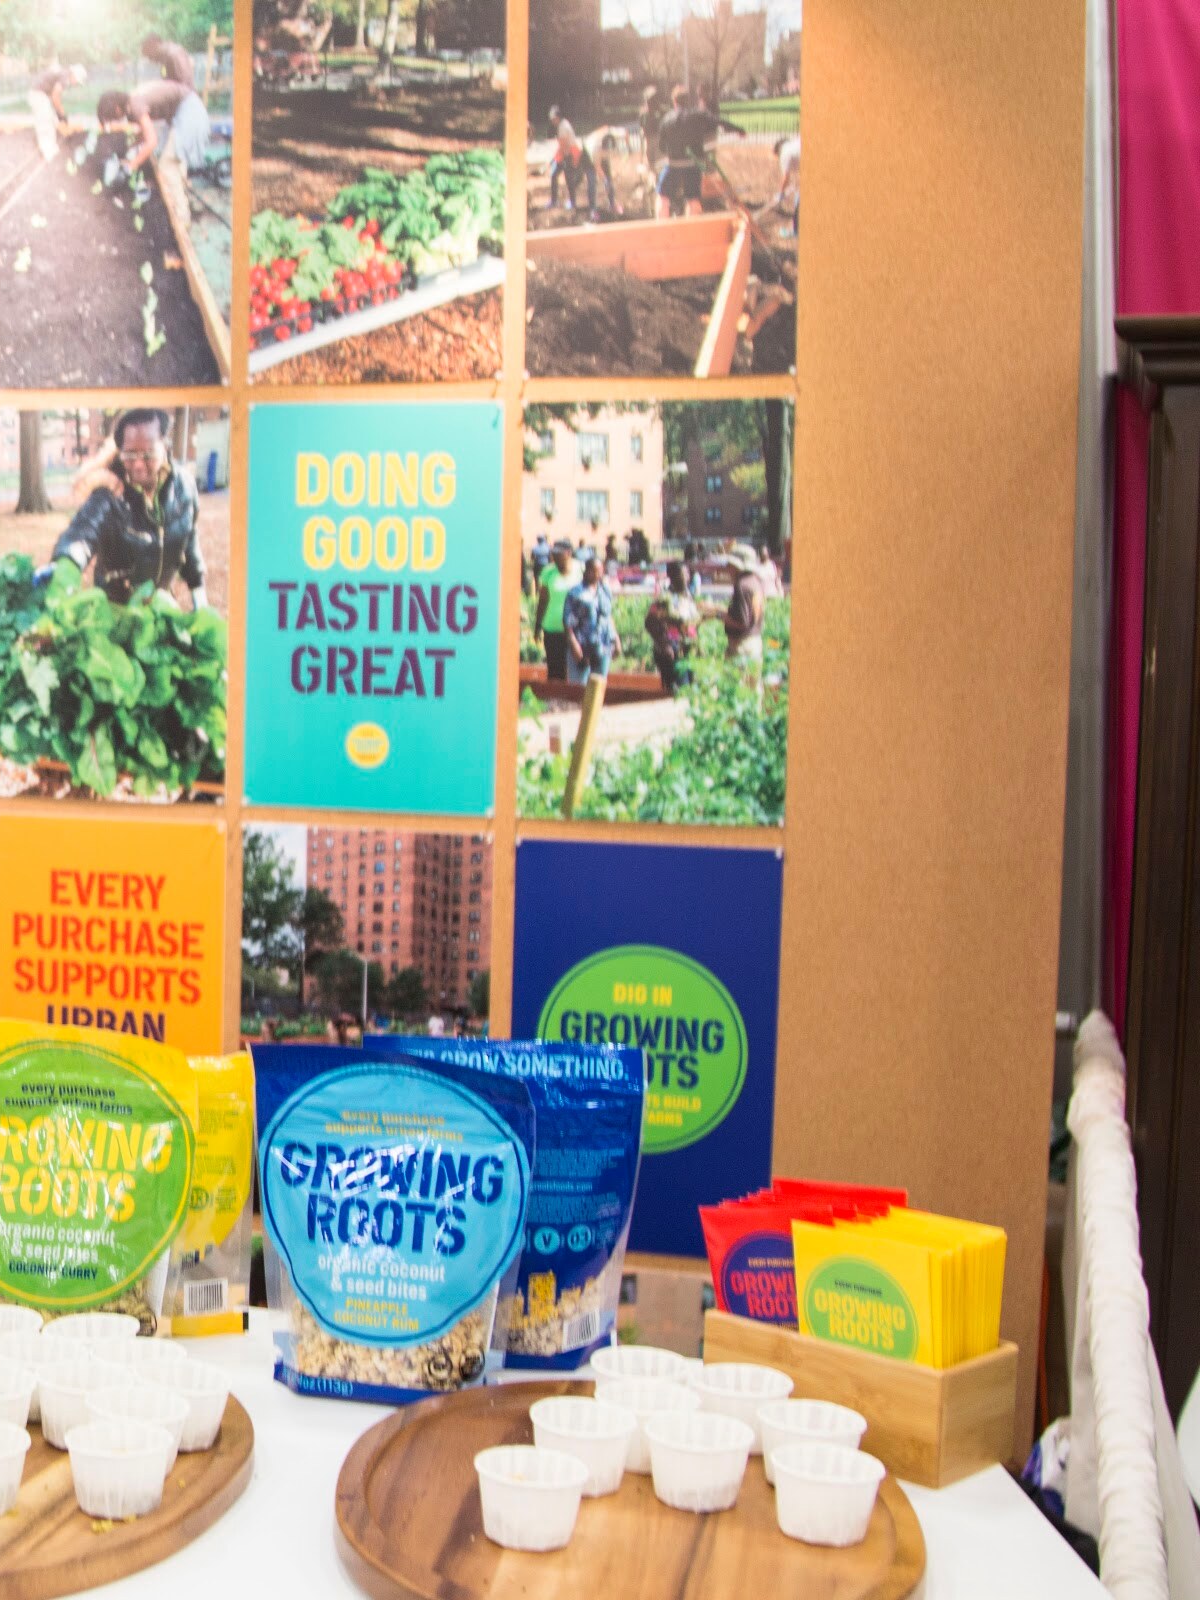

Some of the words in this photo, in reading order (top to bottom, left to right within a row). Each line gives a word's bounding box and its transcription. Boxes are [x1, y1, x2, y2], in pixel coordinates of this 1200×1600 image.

[296, 452, 456, 508] DOING
[302, 515, 446, 572] GOOD
[269, 581, 479, 635] TASTING
[290, 645, 456, 698] GREAT
[50, 869, 166, 911] EVERY
[12, 912, 205, 961] PURCHASE
[14, 956, 202, 1007] SUPPORTS
[613, 982, 647, 1005] DIG
[652, 984, 673, 1007] IN
[560, 1010, 726, 1055] GROWING
[502, 1052, 629, 1081] SOMETHING.
[21, 1082, 55, 1099] every
[58, 1084, 116, 1100] purchase
[279, 1141, 504, 1205] GROWING
[306, 1193, 467, 1257] ROOTS
[25, 1242, 62, 1262] seed
[61, 1263, 98, 1280] CURRY
[380, 1259, 446, 1283] coconut
[330, 1272, 342, 1293] &
[346, 1274, 384, 1296] seed
[387, 1277, 427, 1301] bites
[345, 1298, 408, 1316] PINEAPPLE
[334, 1311, 382, 1328] COCONUT
[388, 1316, 420, 1333] RUM
[814, 1288, 906, 1331] GROWING
[829, 1307, 895, 1350] ROOTS
